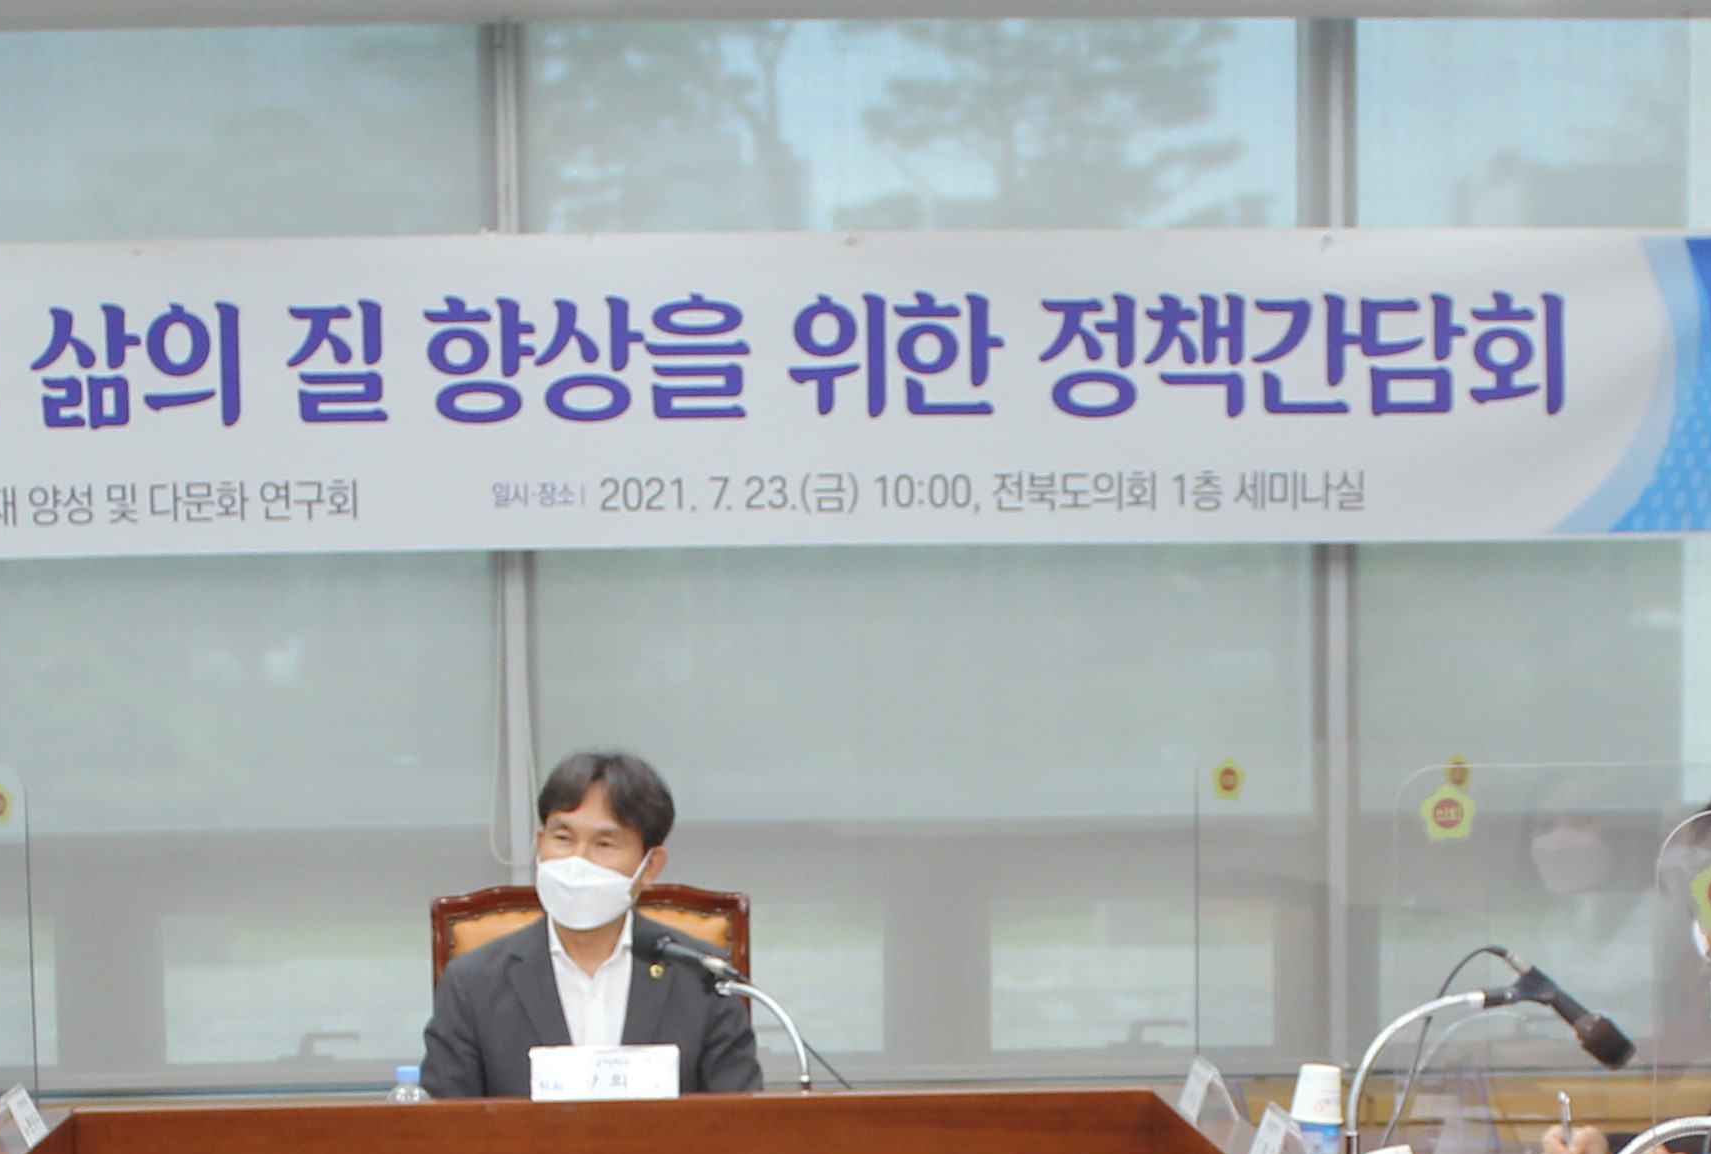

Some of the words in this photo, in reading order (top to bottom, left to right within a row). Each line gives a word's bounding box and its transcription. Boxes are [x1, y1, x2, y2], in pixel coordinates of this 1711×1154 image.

[30, 303, 242, 430] 삶의
[286, 299, 389, 423] 질
[426, 294, 752, 424] 향상을
[788, 292, 1004, 418] 위한
[1039, 292, 1566, 418] 정책간담회
[27, 483, 96, 528] 양성
[106, 483, 139, 526] 및
[148, 481, 251, 525] 다문화
[259, 478, 360, 523] 연구회
[600, 476, 699, 514] 2021.
[708, 475, 734, 513] 7.
[744, 471, 861, 515] 23.(금)
[874, 473, 982, 515] 10:00,
[992, 470, 1159, 514] 전북도의회
[1173, 469, 1225, 514] 1층
[1233, 468, 1367, 513] 세미나실
